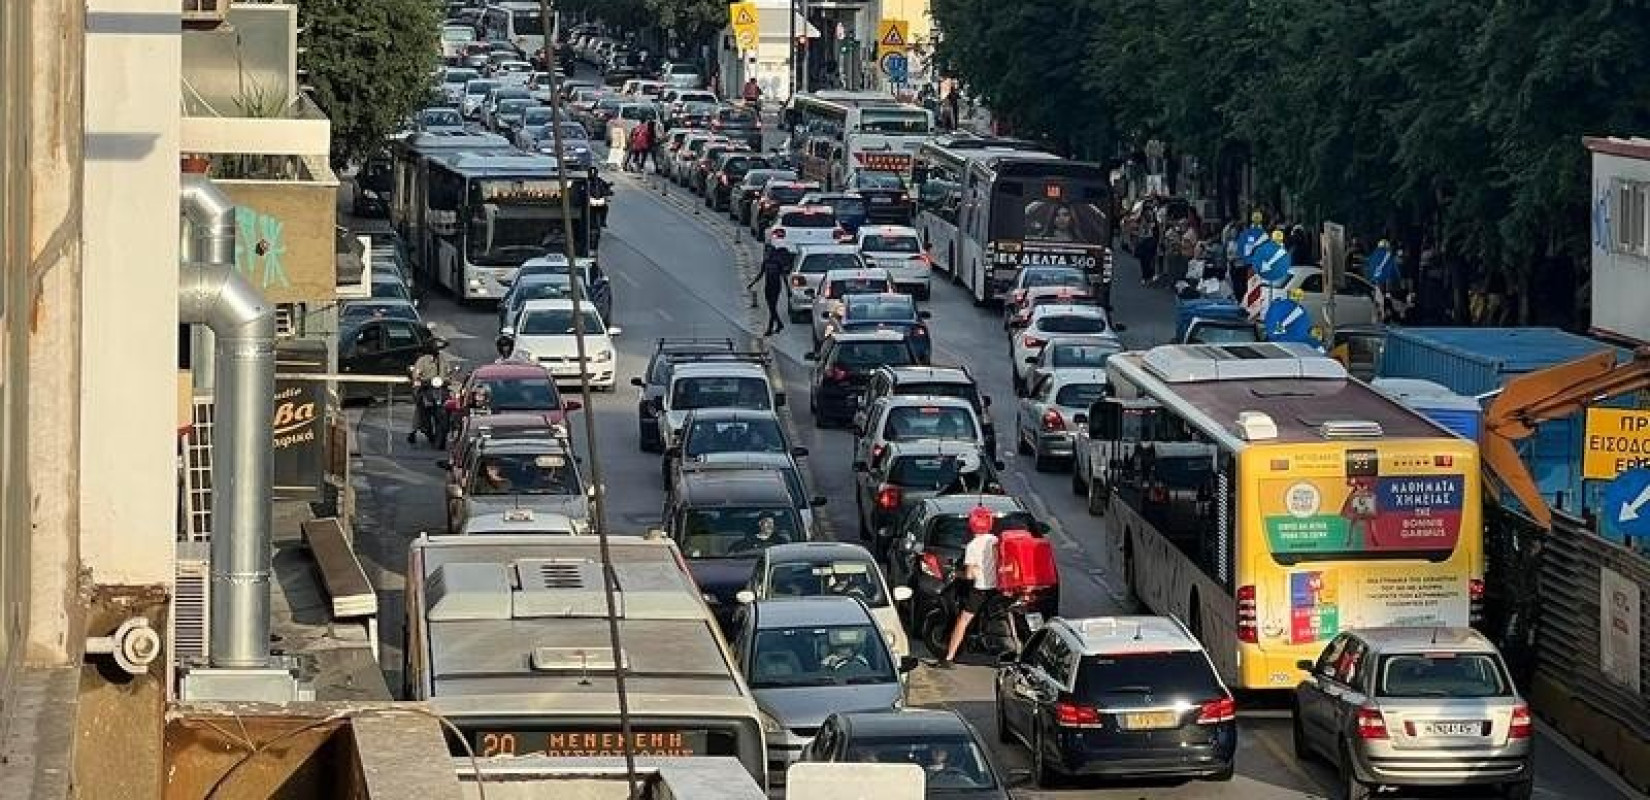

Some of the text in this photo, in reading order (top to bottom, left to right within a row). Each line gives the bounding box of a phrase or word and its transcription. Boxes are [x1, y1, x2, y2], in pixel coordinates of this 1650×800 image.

[1620, 416, 1649, 431] ΠΡ
[1589, 434, 1650, 453] ΕΙΣΟΔΟ
[484, 733, 515, 757] 20
